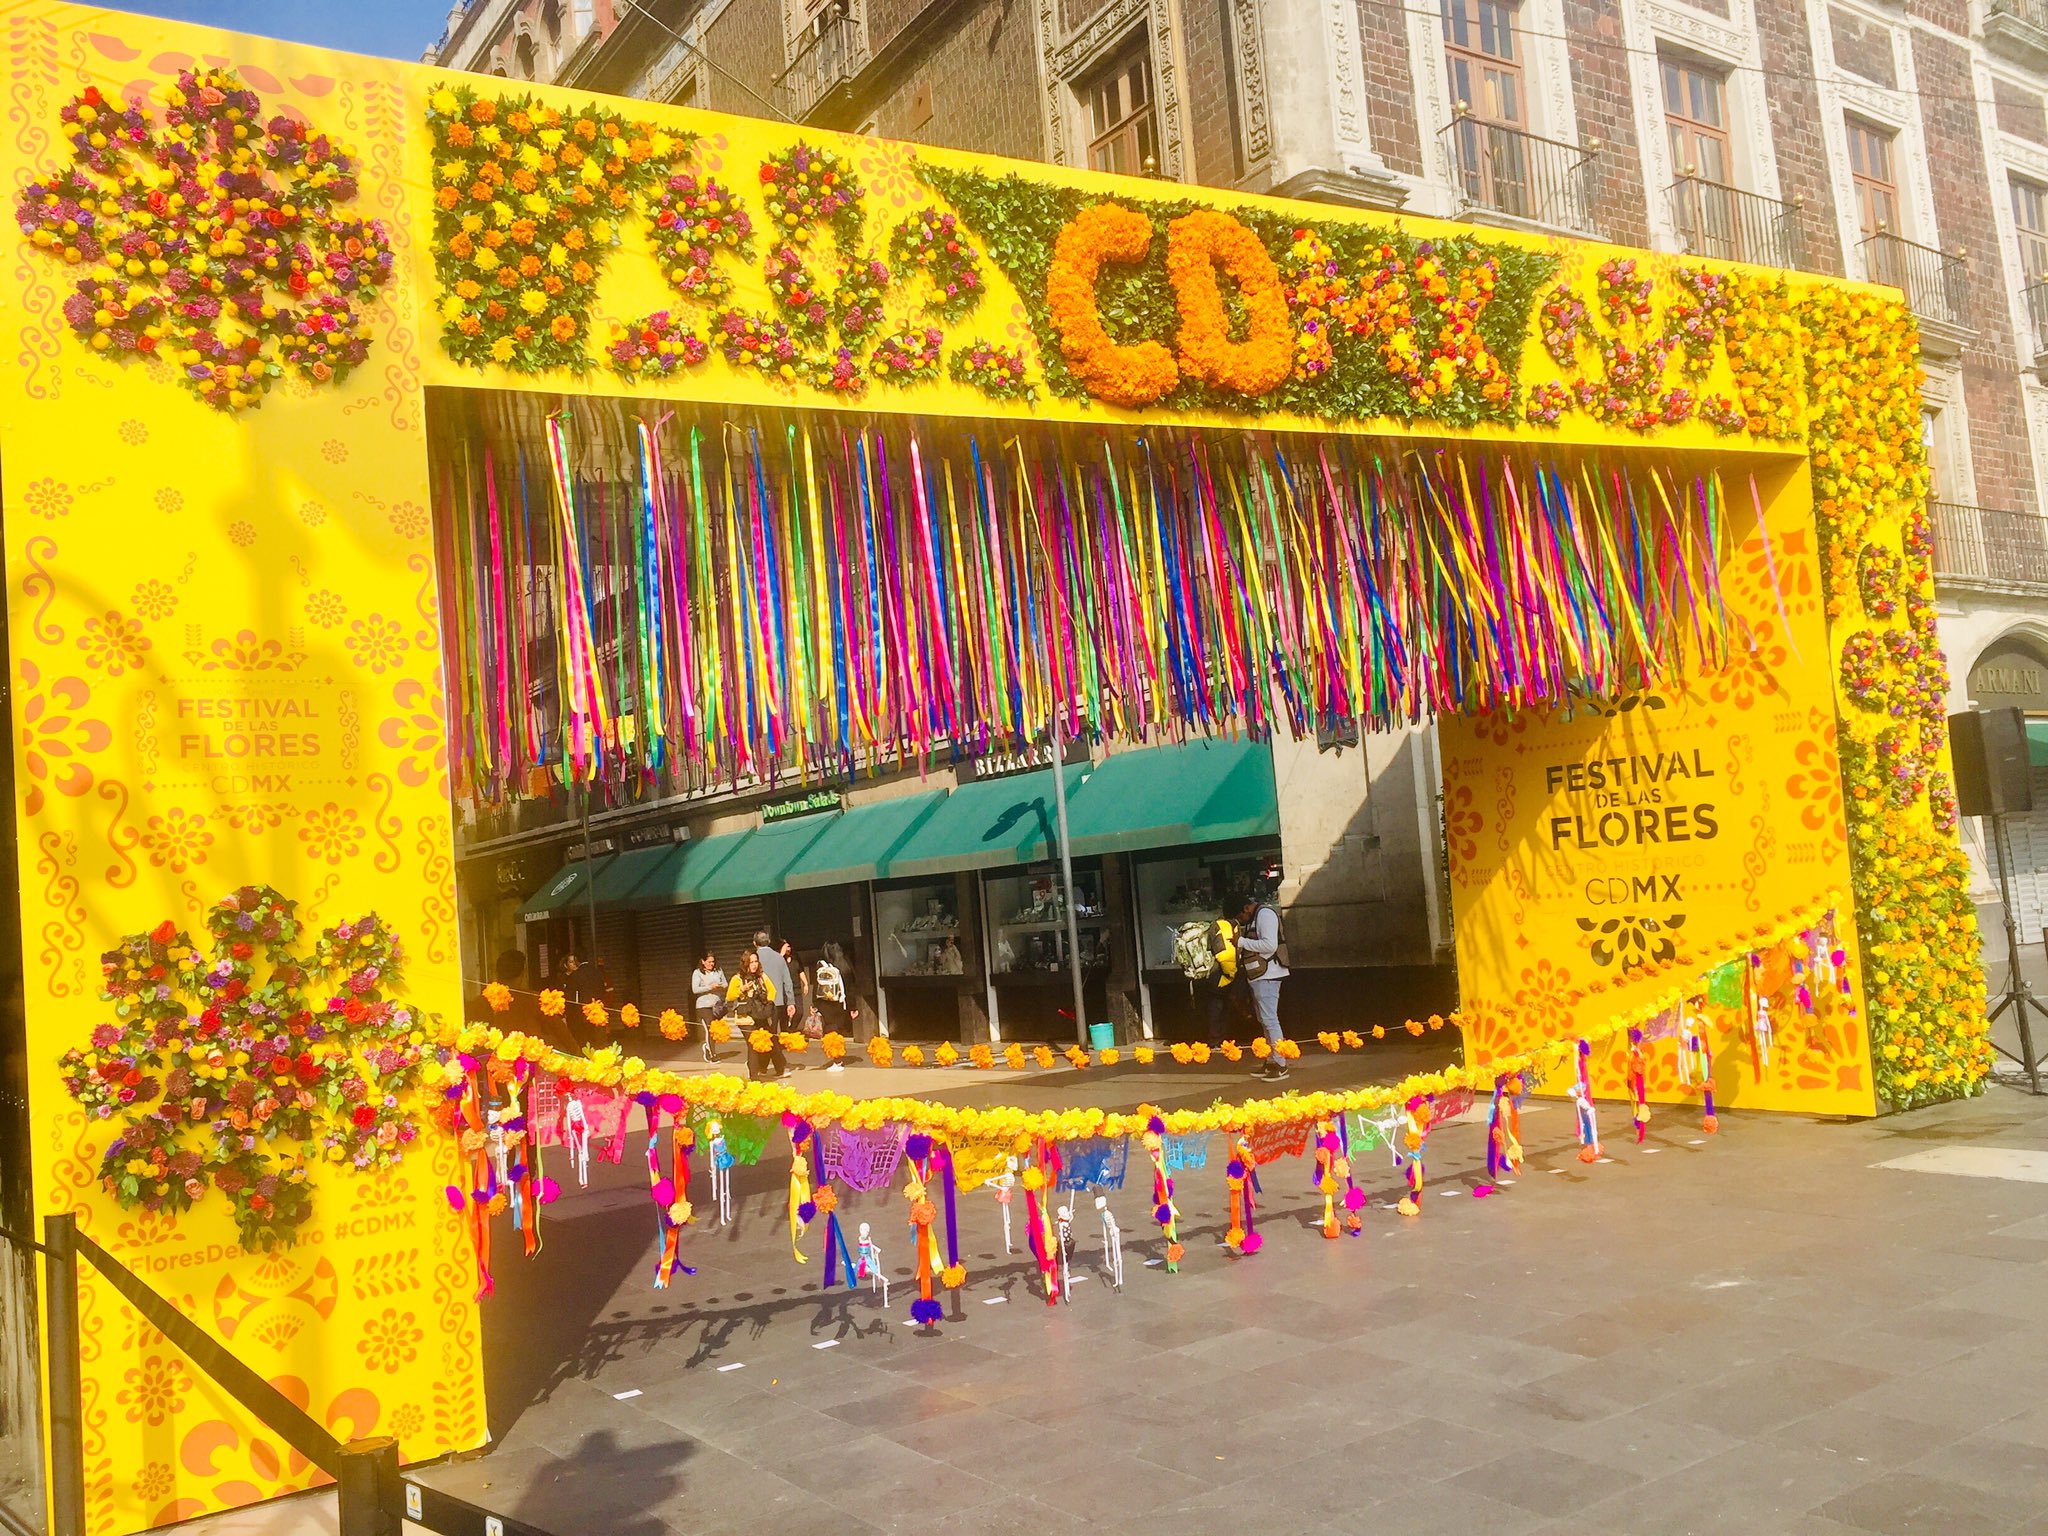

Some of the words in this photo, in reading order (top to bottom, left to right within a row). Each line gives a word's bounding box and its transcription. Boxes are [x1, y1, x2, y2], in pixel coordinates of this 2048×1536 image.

[1976, 668, 2041, 694] ARMANI
[177, 698, 320, 719] FESTIVAL
[223, 721, 244, 732] DE
[249, 721, 279, 732] LAS
[180, 733, 321, 758] FLORES
[1545, 748, 1715, 794] FESTIVAL
[211, 774, 293, 794] CDMX
[1596, 791, 1621, 808] DE
[1627, 788, 1662, 807] LAS
[1550, 803, 1719, 851] FLORES
[1585, 874, 1683, 905] CDMX
[335, 1210, 417, 1240] #CDMX
